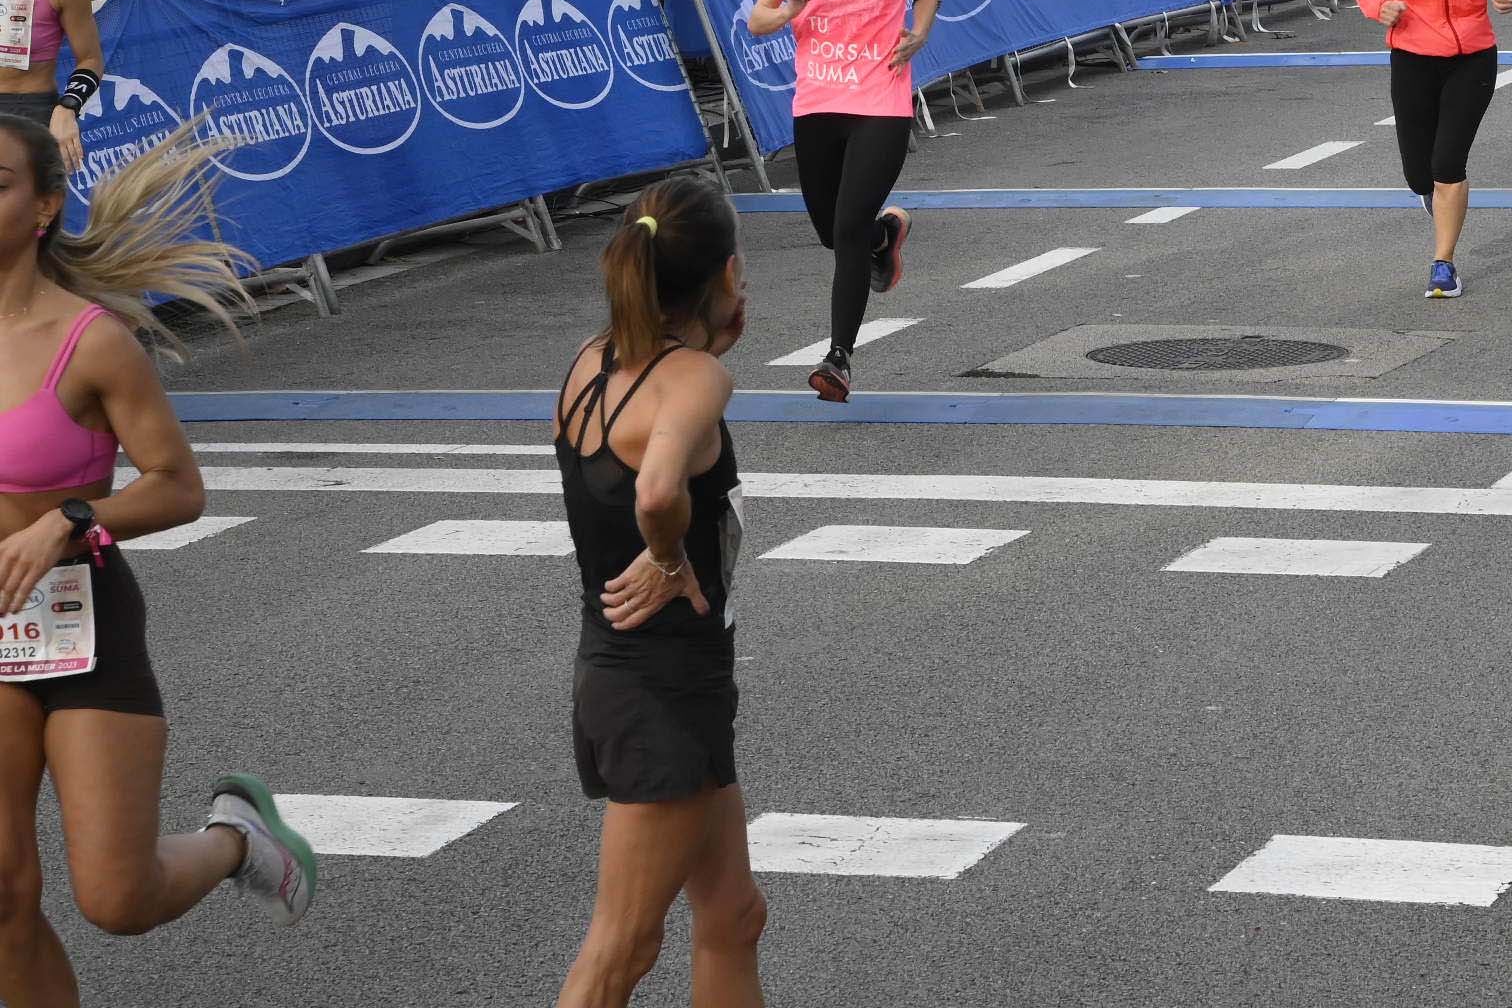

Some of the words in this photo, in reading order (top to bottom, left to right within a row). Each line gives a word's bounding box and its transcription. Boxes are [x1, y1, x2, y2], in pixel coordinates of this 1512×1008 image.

[626, 15, 659, 30] CENTRAL
[808, 16, 829, 34] TU
[532, 32, 562, 47] CENTRAL
[562, 27, 592, 42] LECHERA
[617, 23, 677, 68] ASTUR
[438, 45, 473, 62] CENTRAL
[472, 41, 504, 57] LECHERA
[810, 38, 882, 62] DORSAL
[326, 67, 361, 85] CENTRAL
[362, 60, 401, 78] LECHERA
[524, 39, 610, 85] ASTURIANA
[807, 61, 859, 83] SUMA
[429, 54, 521, 103] ASTURIANA
[212, 90, 252, 109] CENTRAL
[316, 74, 416, 128] ASTURIANA
[201, 100, 306, 150] ASTURIANA
[49, 583, 81, 594] SUMA
[27, 663, 56, 672] MUJER
